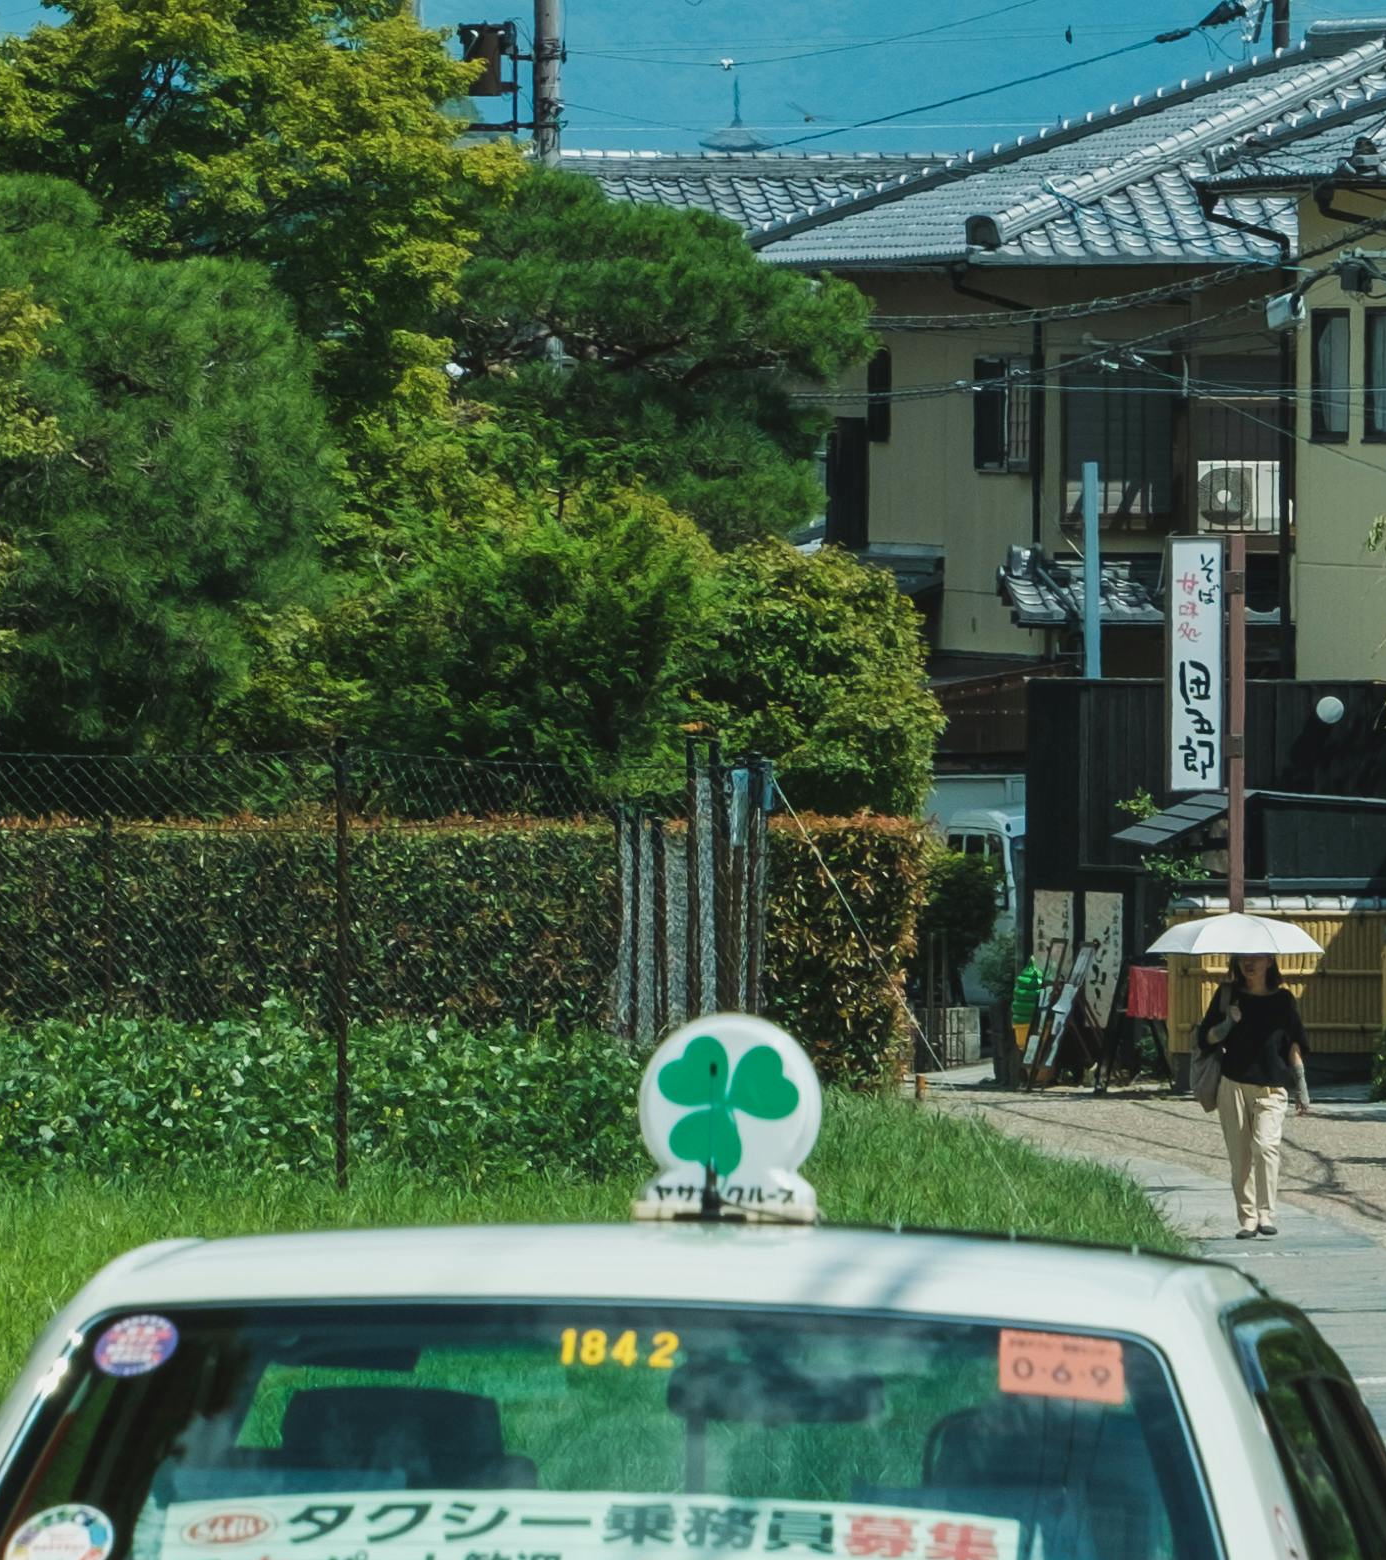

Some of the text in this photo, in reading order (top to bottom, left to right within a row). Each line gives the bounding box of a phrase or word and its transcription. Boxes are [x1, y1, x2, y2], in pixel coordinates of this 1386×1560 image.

[1198, 554, 1220, 605] そば
[1176, 572, 1202, 643] 甘味処
[561, 1327, 680, 1368] 1842
